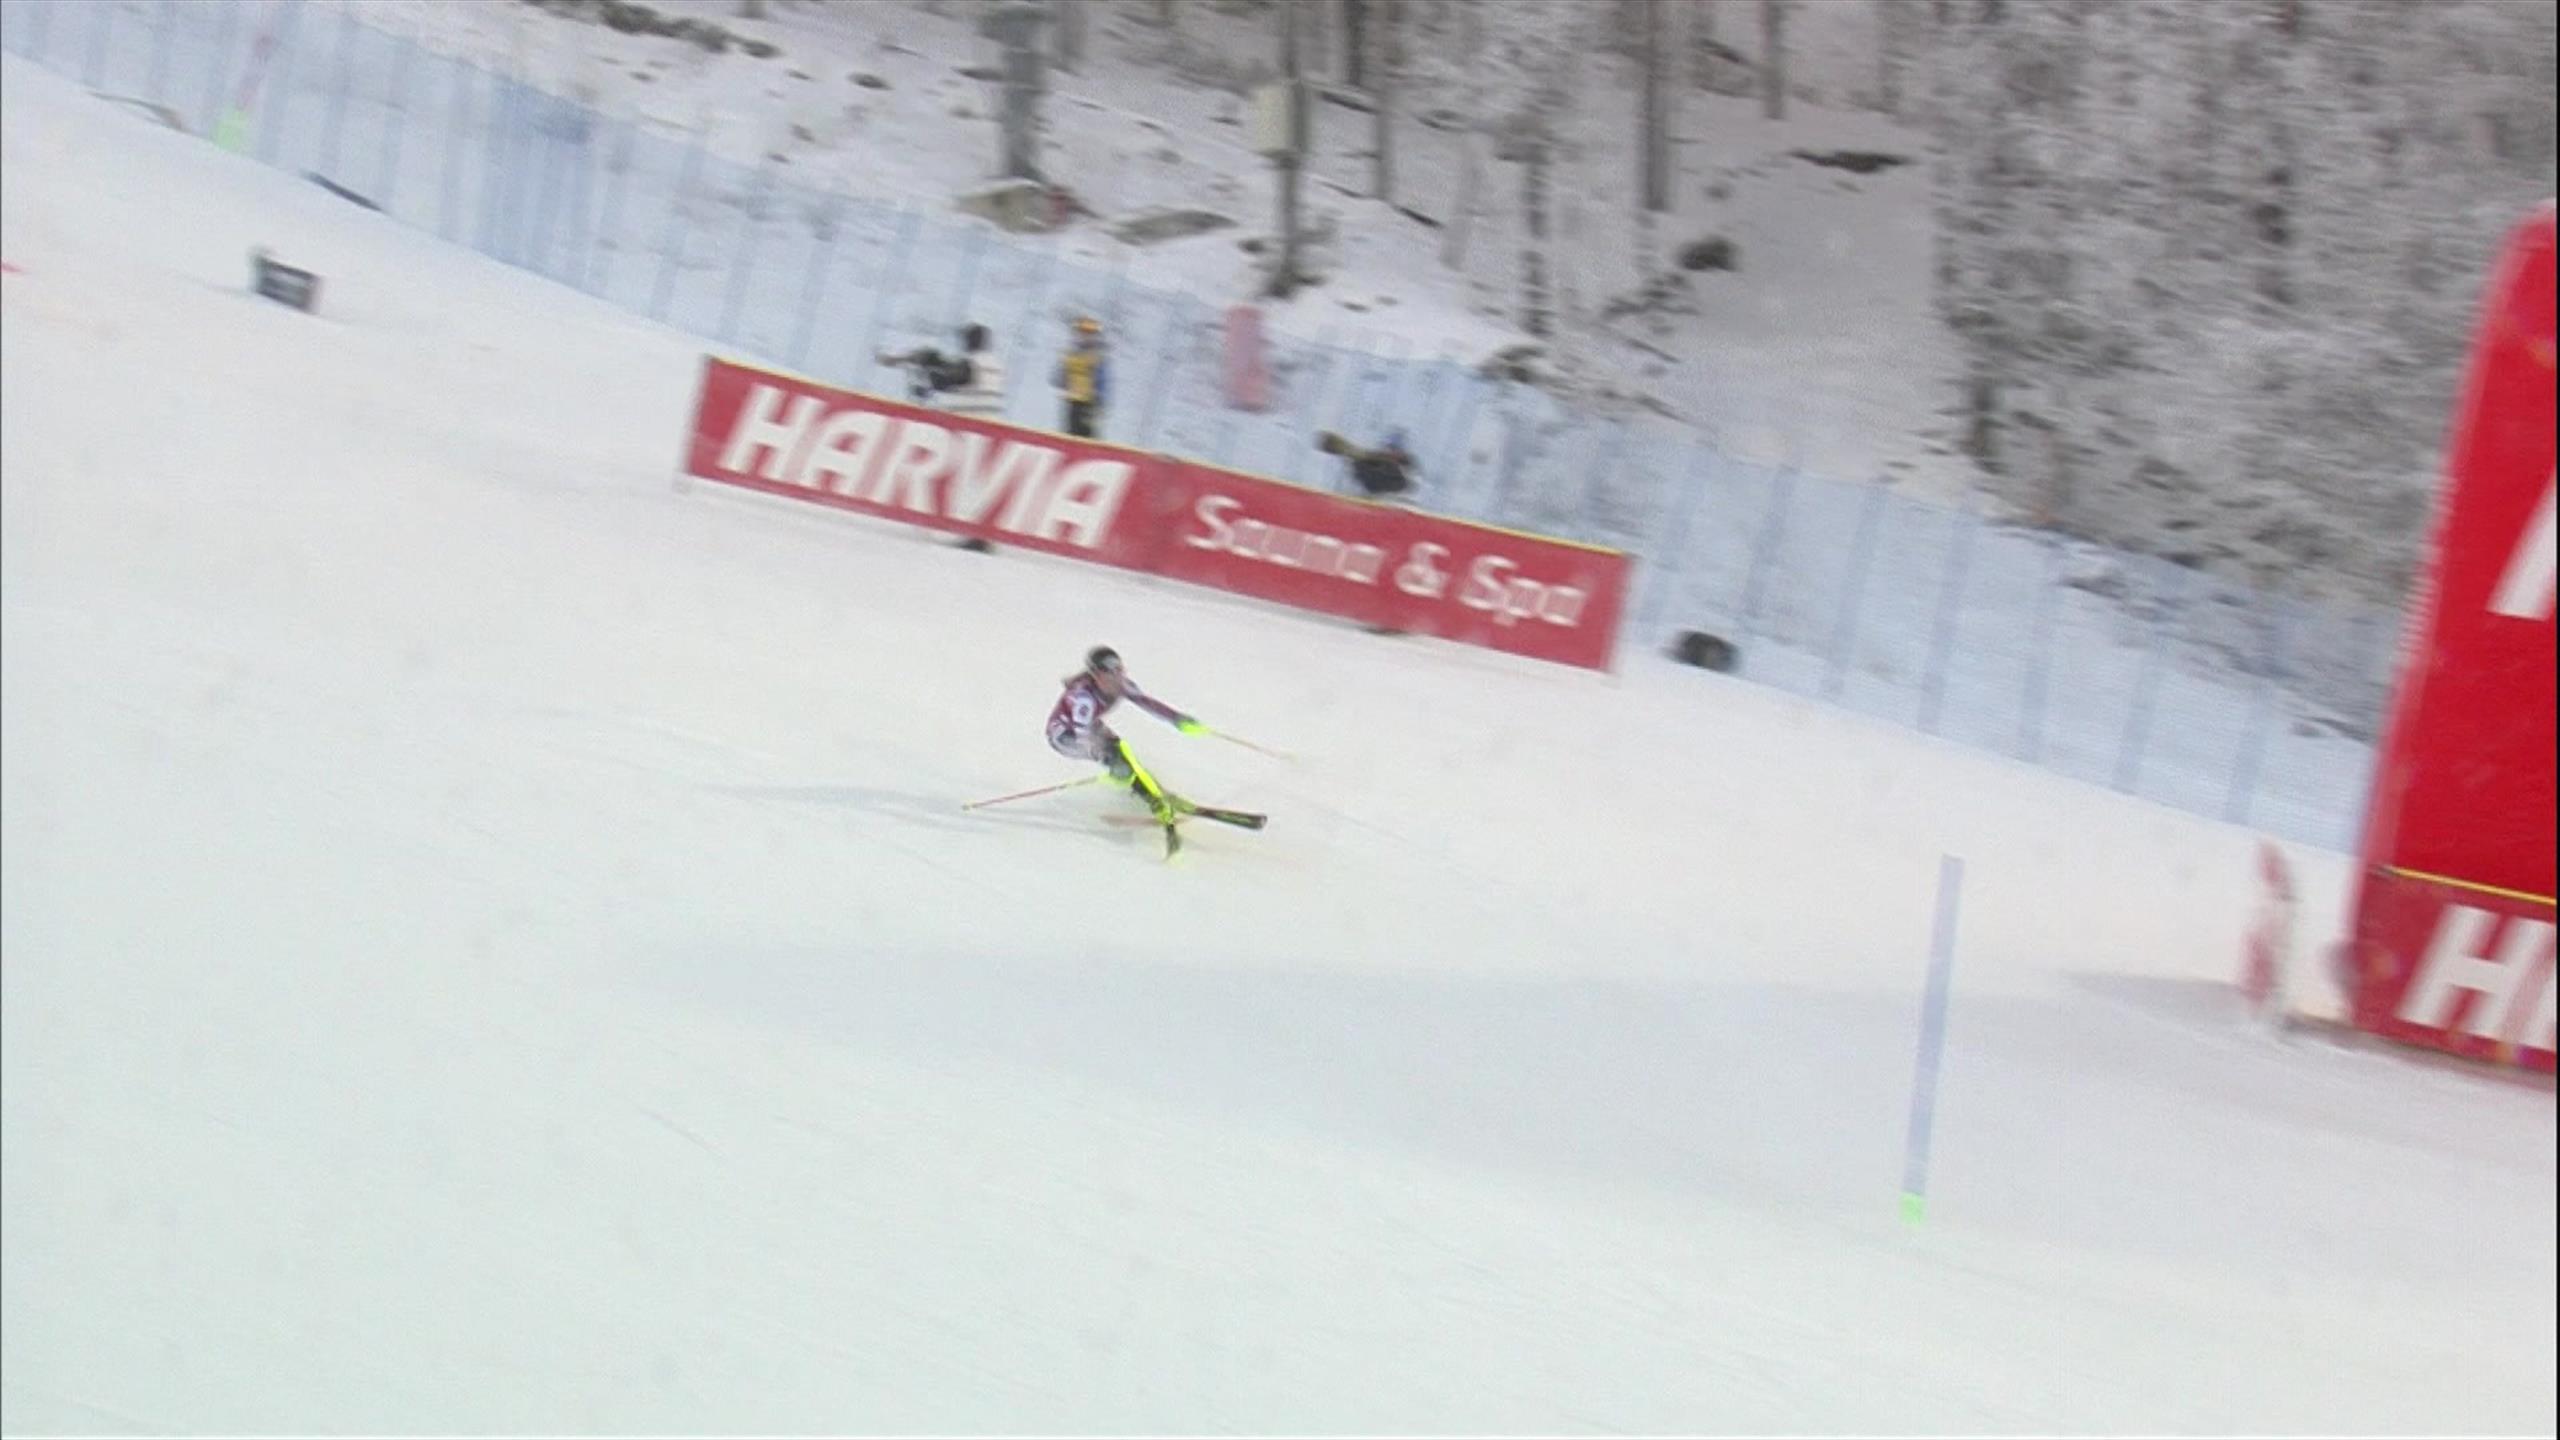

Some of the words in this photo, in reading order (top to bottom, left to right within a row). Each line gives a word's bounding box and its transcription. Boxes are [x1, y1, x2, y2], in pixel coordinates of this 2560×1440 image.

[720, 385, 1135, 547] HARVIA
[1186, 495, 1383, 583] Sauna
[1395, 541, 1450, 598] &
[1461, 555, 1588, 626] Spa
